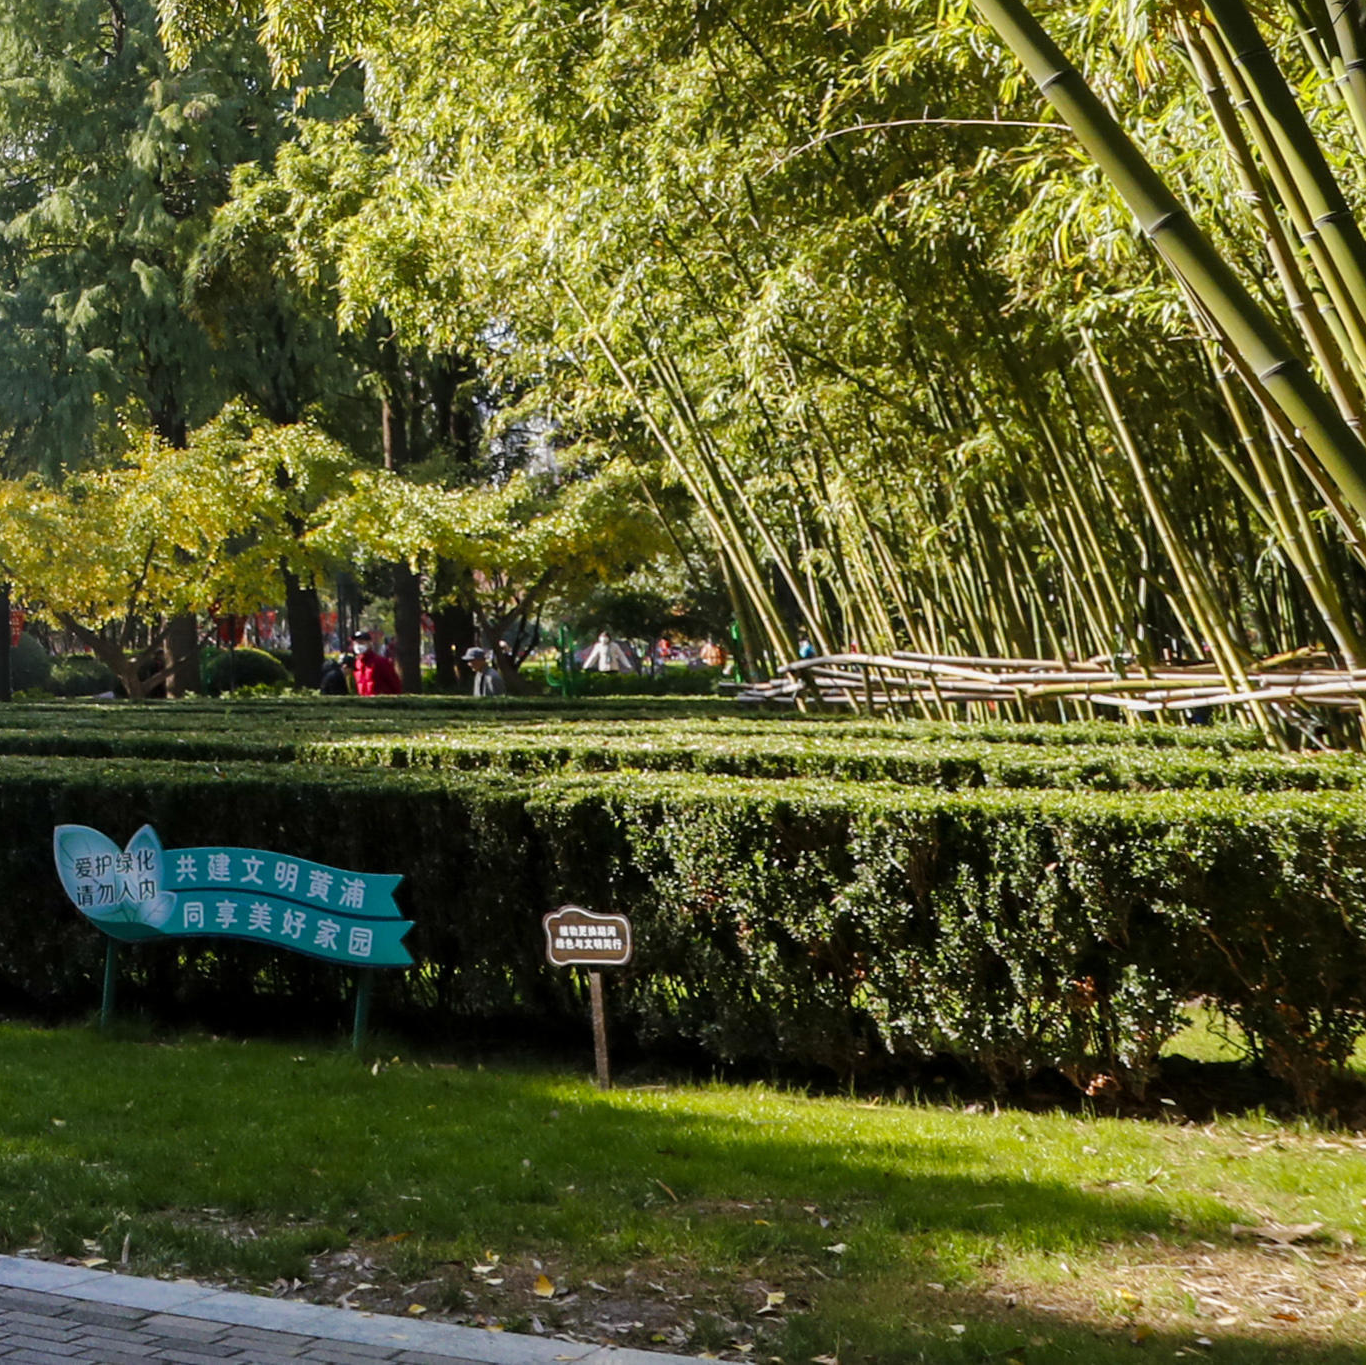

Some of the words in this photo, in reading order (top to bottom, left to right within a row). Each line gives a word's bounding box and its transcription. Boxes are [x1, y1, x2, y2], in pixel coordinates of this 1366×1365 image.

[75, 849, 155, 878] 爱护绿化
[176, 853, 366, 909] 共建文明黄浦
[77, 878, 155, 907] 请勿入内
[183, 899, 373, 957] 同享美好家园
